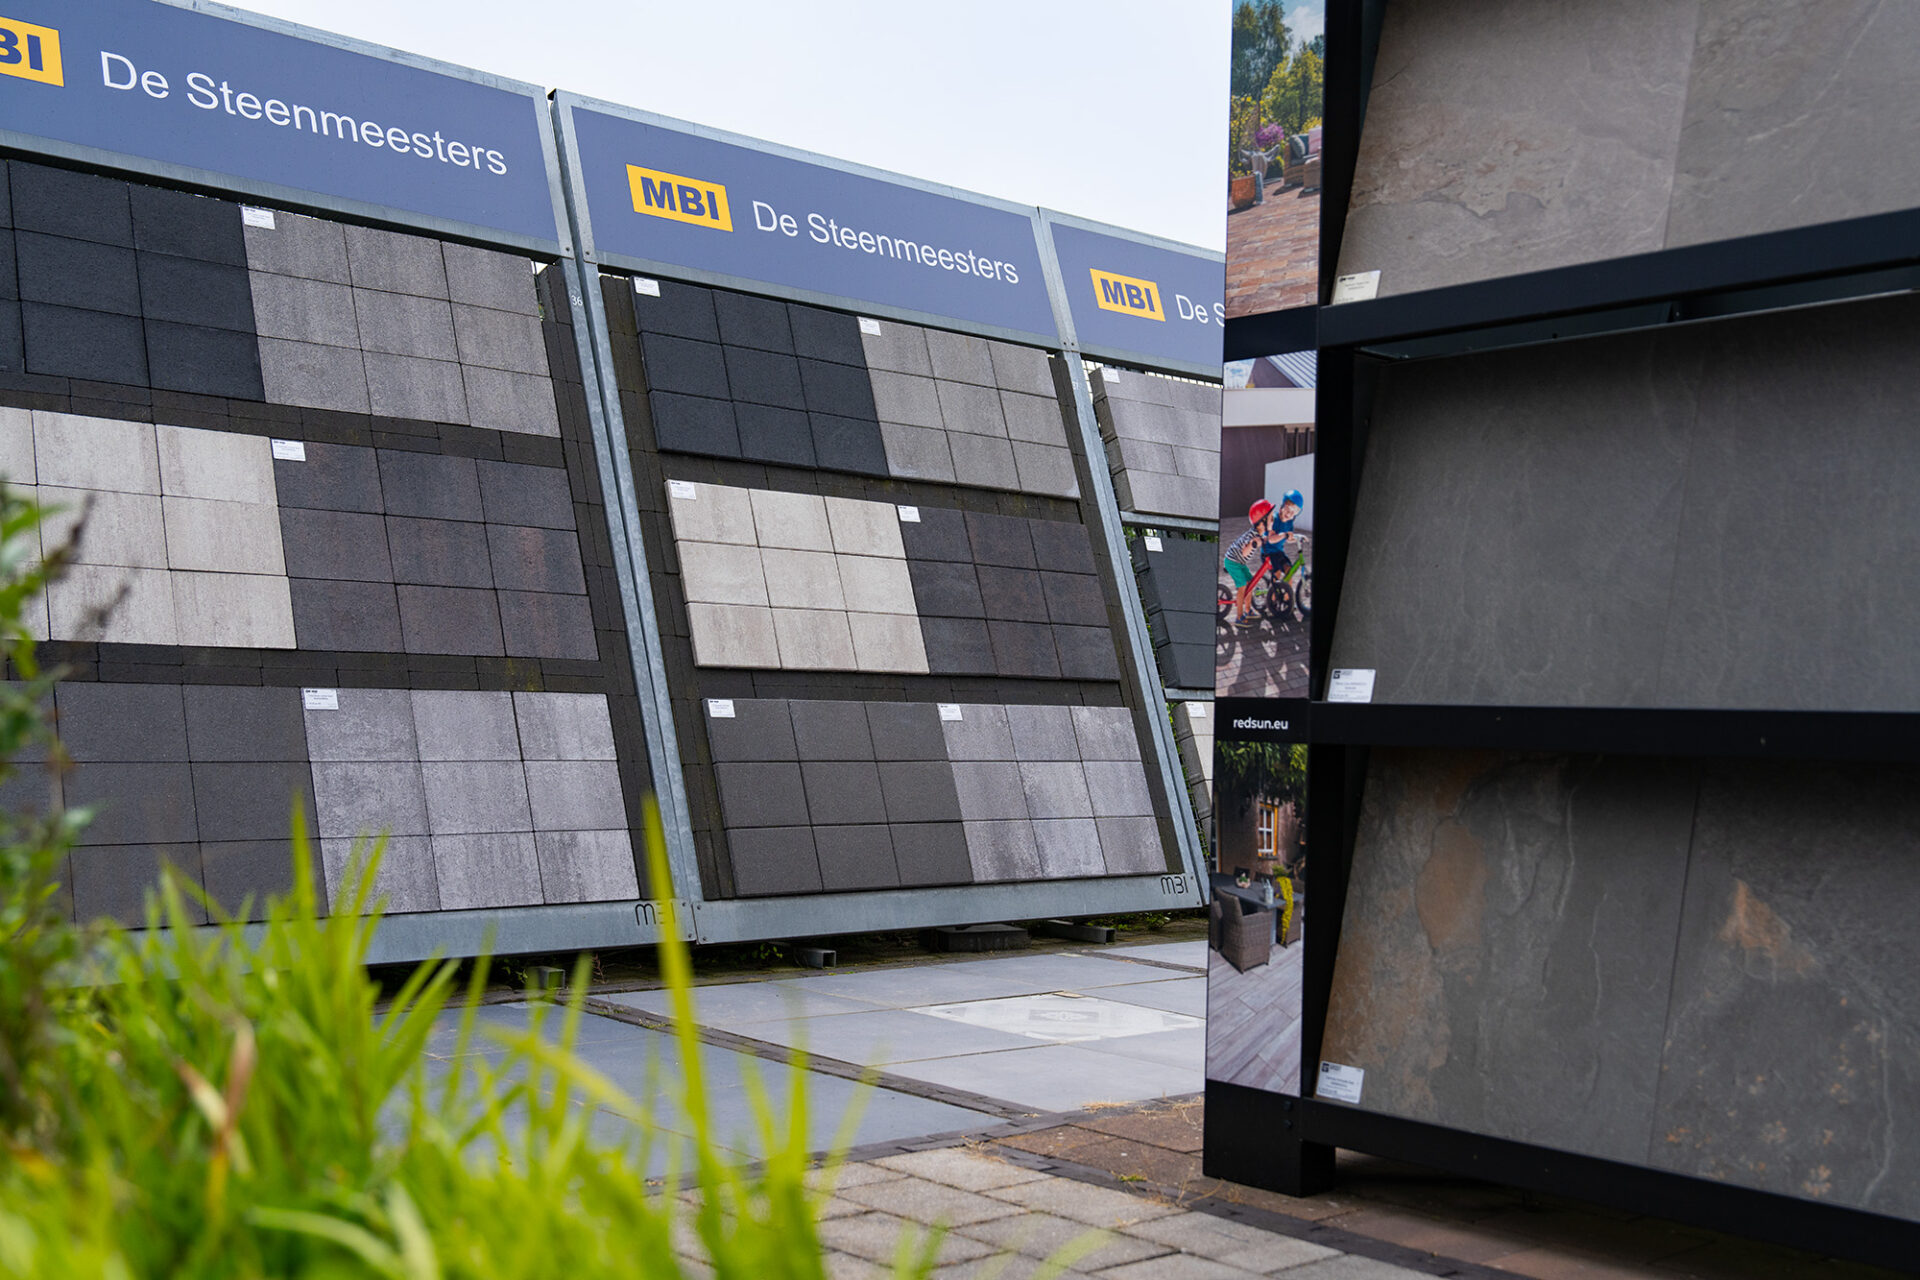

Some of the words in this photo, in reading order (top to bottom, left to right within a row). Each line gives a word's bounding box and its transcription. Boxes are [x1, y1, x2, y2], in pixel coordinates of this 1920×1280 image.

[101, 51, 169, 99] De
[187, 72, 507, 175] Steenmeesters
[640, 176, 720, 221] MBI
[752, 201, 799, 237] De
[808, 214, 1019, 284] Steenmeesters
[571, 295, 583, 306] 36
[1100, 278, 1155, 312] MBI
[1175, 294, 1209, 324] De
[1233, 717, 1288, 730] redsun.eu
